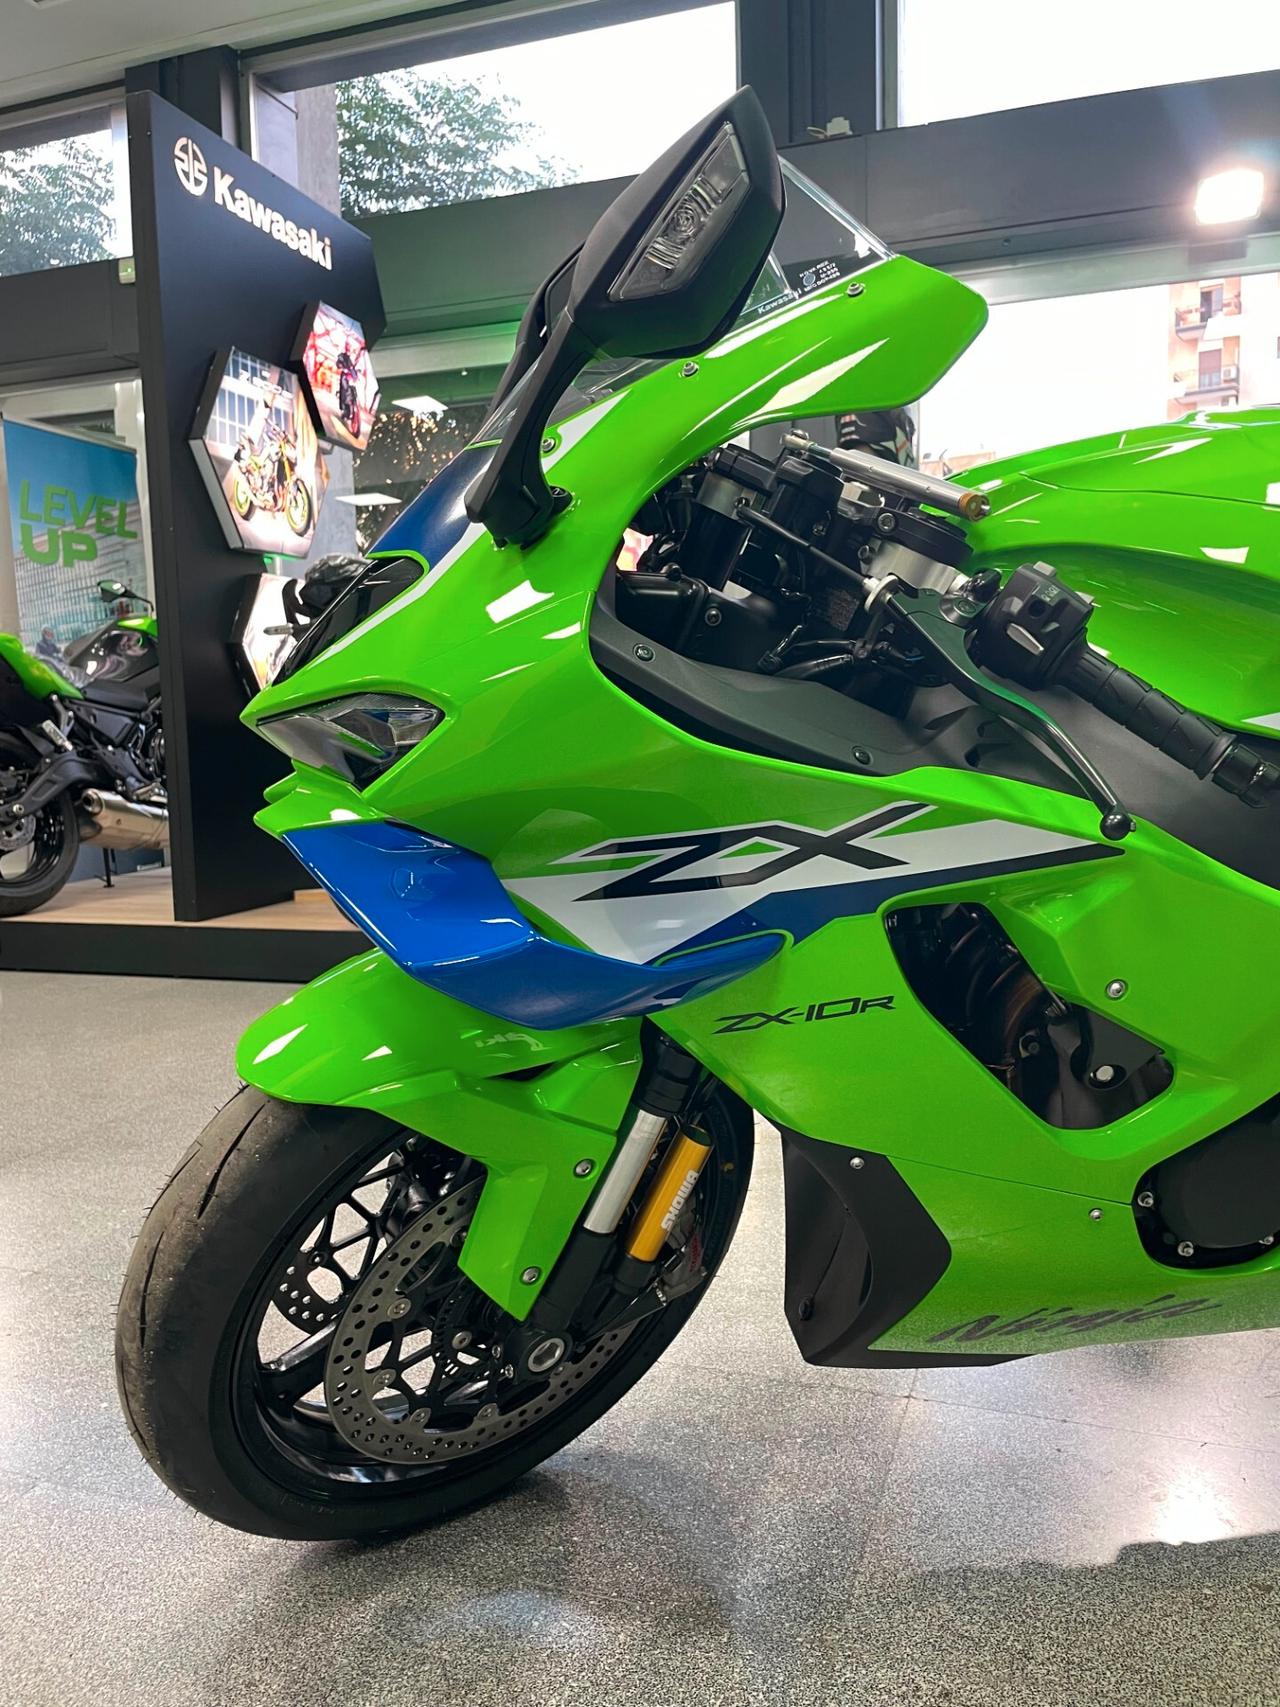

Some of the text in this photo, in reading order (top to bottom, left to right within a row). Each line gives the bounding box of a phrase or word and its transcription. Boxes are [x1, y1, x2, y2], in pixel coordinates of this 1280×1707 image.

[213, 166, 332, 270] Kawasaki
[20, 479, 138, 539] LEVEL
[20, 523, 98, 568] UP
[566, 801, 935, 902] ZX
[712, 995, 896, 1034] ZX-10R
[661, 1169, 699, 1231] SHOWA
[926, 1294, 1222, 1342] Ninja
